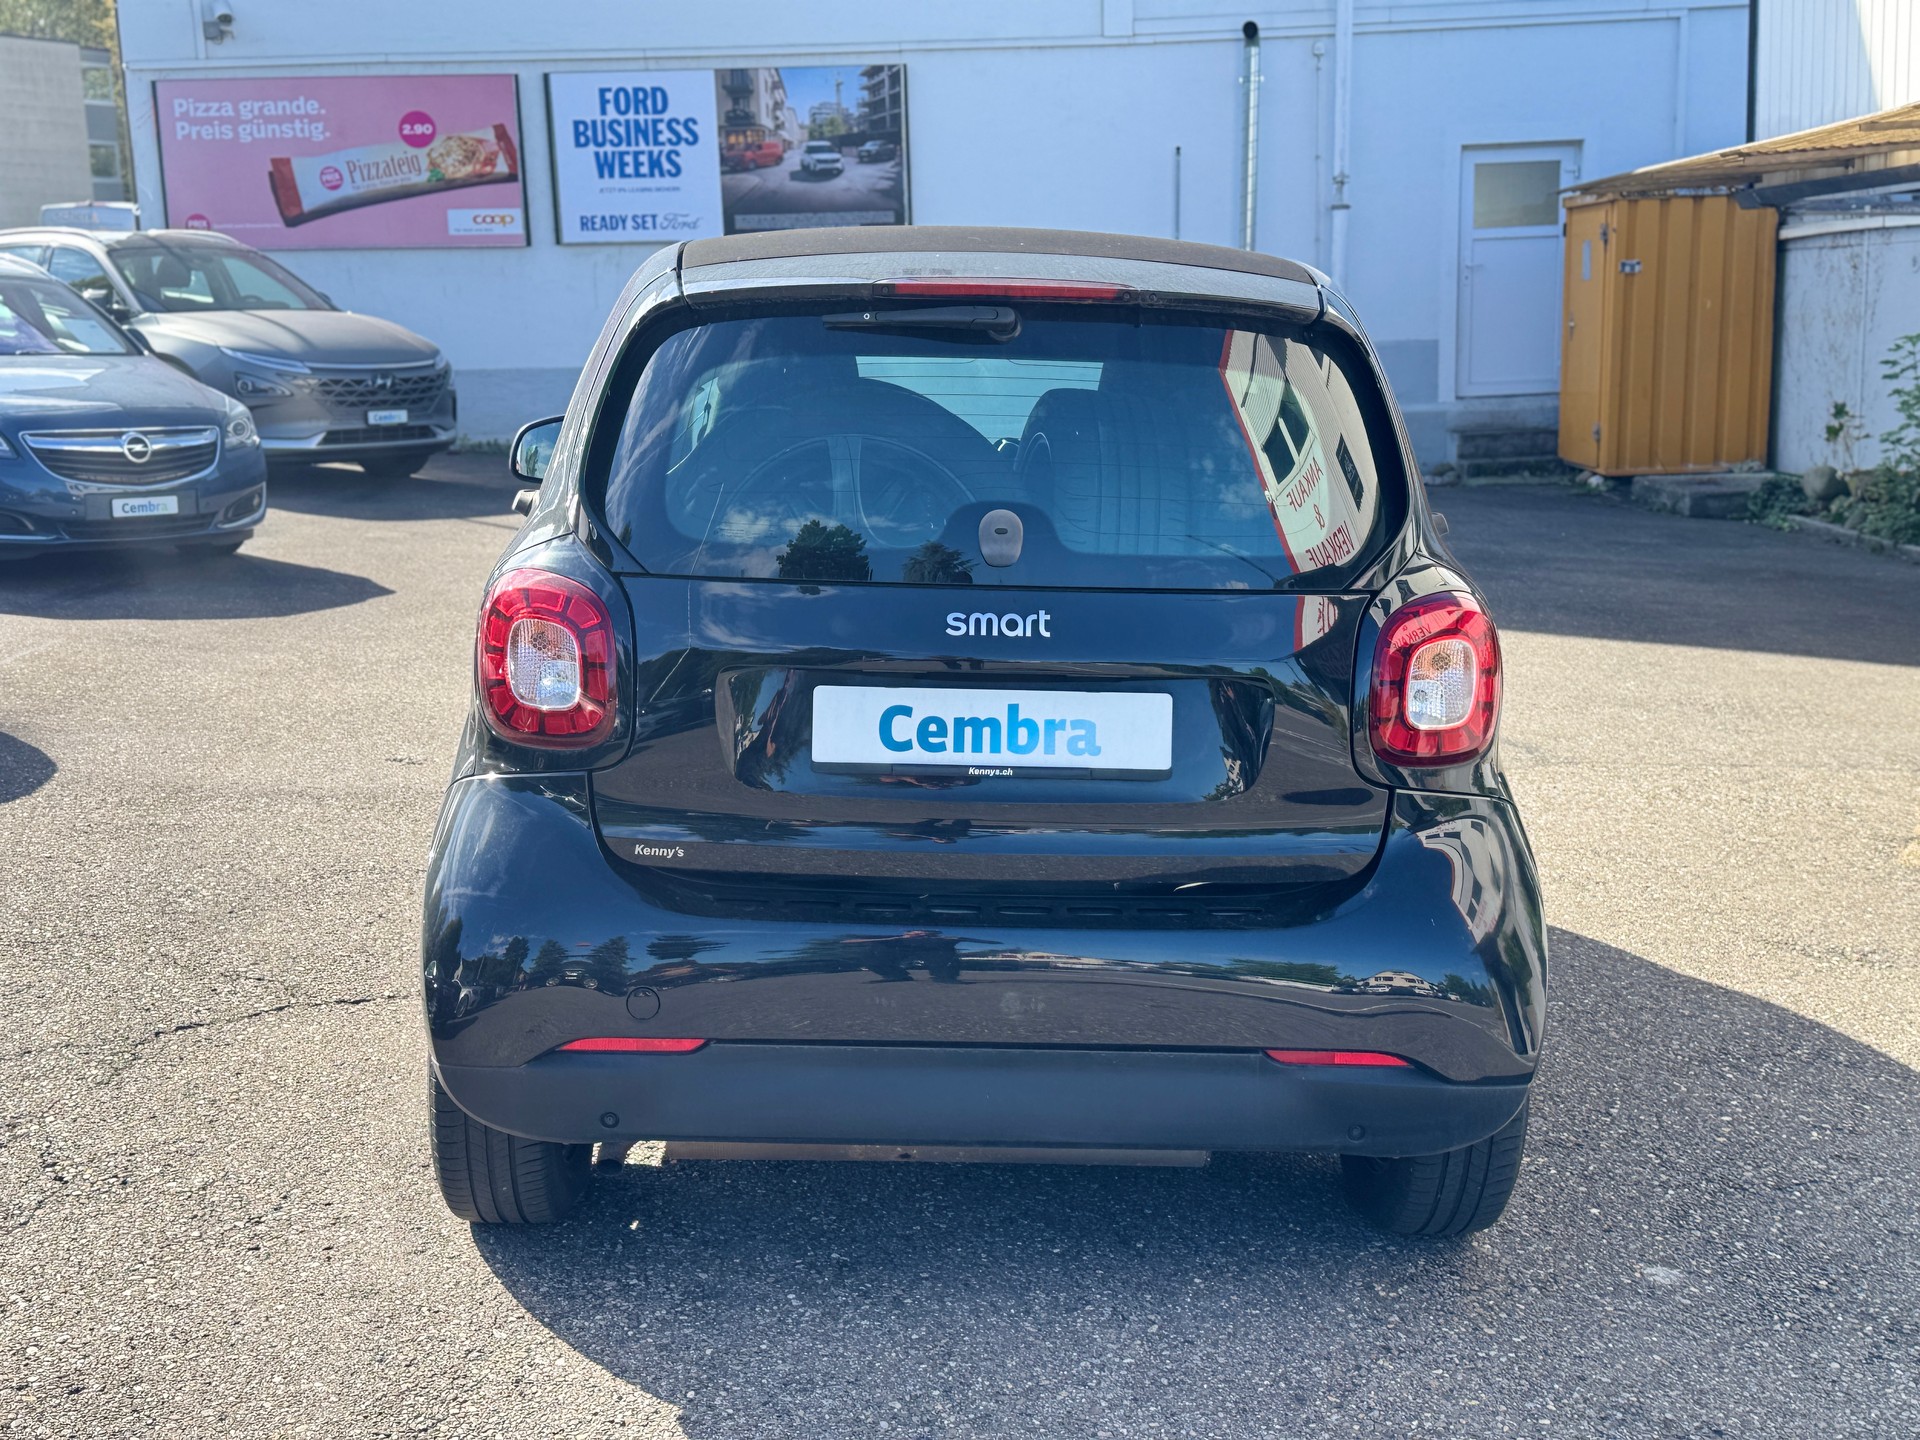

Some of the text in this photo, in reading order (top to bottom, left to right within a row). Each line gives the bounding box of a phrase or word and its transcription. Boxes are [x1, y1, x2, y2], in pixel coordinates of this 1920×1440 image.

[173, 95, 327, 120] Pizza grande.
[598, 86, 669, 116] FORD
[175, 118, 331, 143] Preis günstig.
[402, 123, 434, 135] 2.90
[572, 117, 699, 148] BUSINESS
[345, 151, 422, 184] Pizzateig
[593, 149, 682, 179] WEEKS
[472, 214, 515, 227] coop
[579, 212, 704, 232] READY SET Ford
[121, 500, 169, 514] Cembra
[945, 609, 1051, 638] smart
[878, 703, 1102, 757] Cembra
[968, 766, 1013, 777] Kennys.ch
[634, 844, 685, 859] Kenny's
